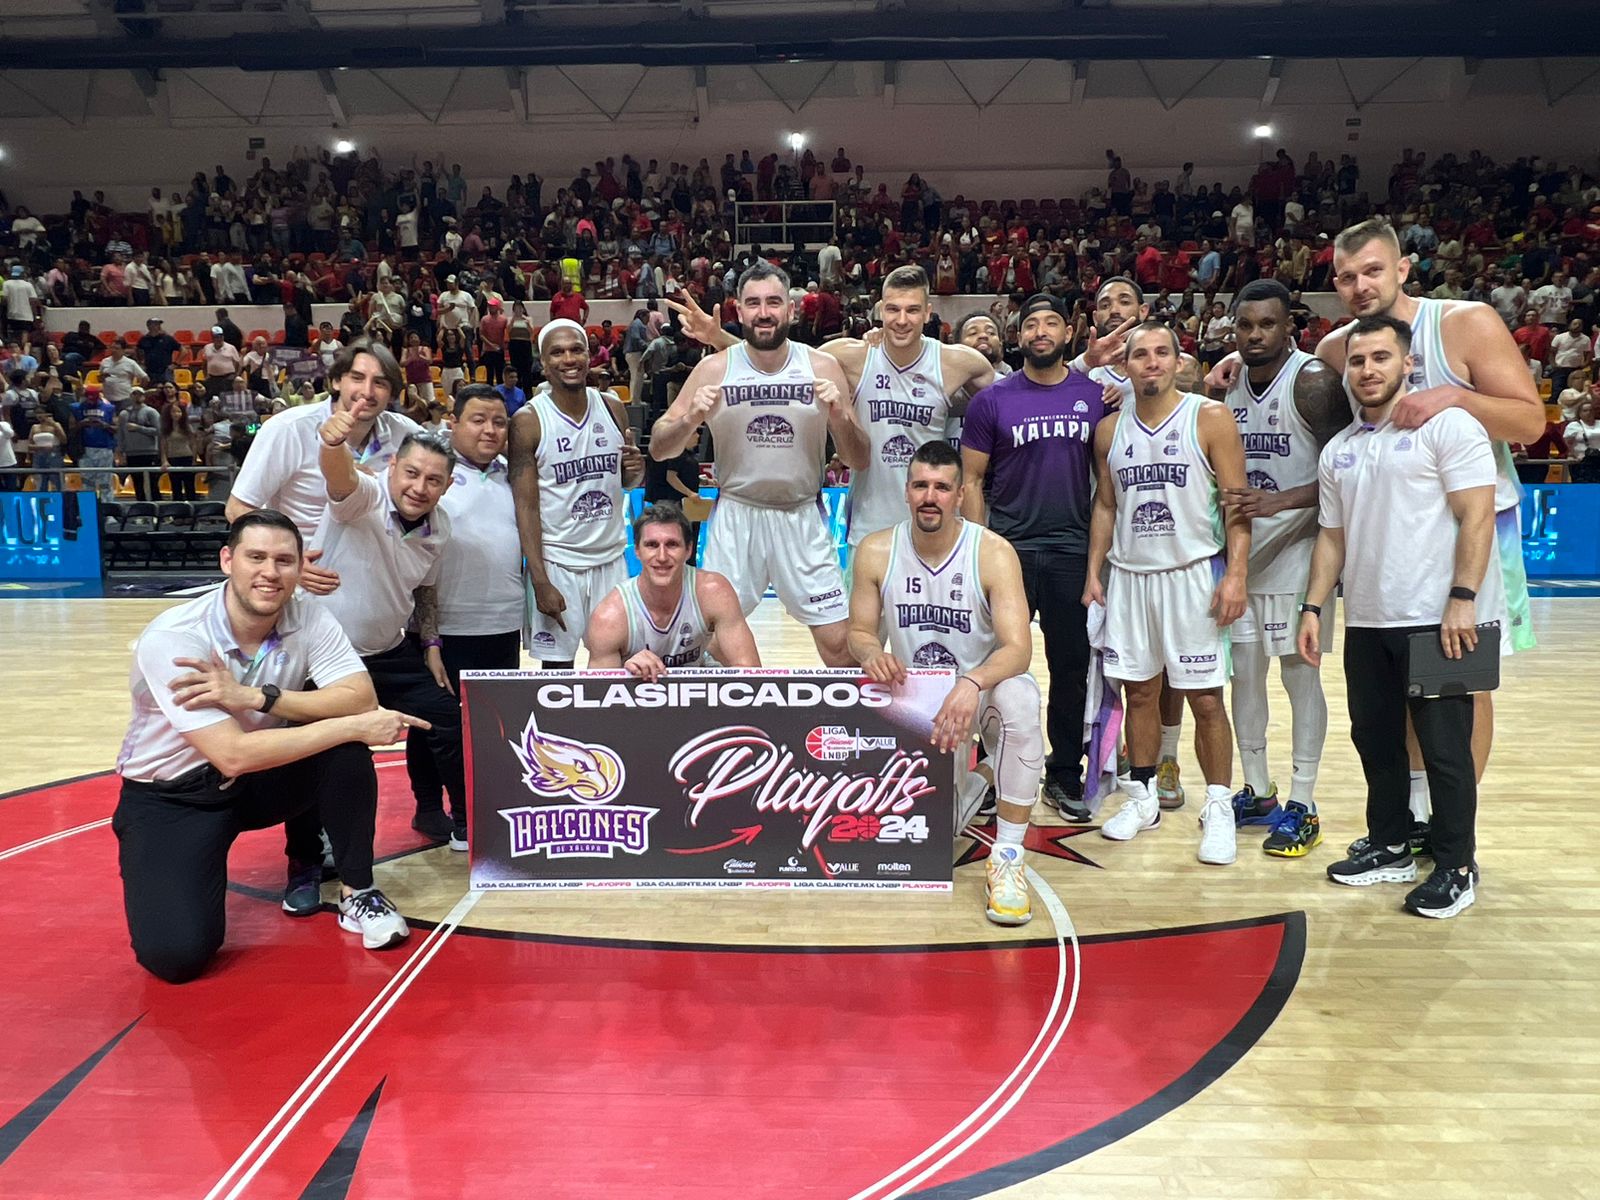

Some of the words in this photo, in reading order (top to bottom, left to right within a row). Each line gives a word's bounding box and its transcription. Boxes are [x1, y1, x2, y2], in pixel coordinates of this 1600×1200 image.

[875, 374, 891, 389] 32
[723, 383, 815, 406] HALCONES
[1233, 408, 1248, 423] 22
[556, 437, 572, 453] 12
[746, 435, 794, 443] VERACRUZ
[1240, 433, 1292, 457] LCONES
[1125, 444, 1134, 459] 4
[552, 453, 619, 485] HALCONES
[906, 577, 921, 594] 15
[895, 603, 973, 634] HALCONES
[537, 682, 892, 709] CLASIFICADOS
[823, 727, 846, 735] LIGA
[823, 751, 848, 760] LNBP
[668, 728, 937, 850] Playoffs
[515, 811, 643, 851] HALCONES
[830, 814, 930, 841] 2024
[723, 858, 757, 869] Caliente
[877, 862, 912, 871] molten
